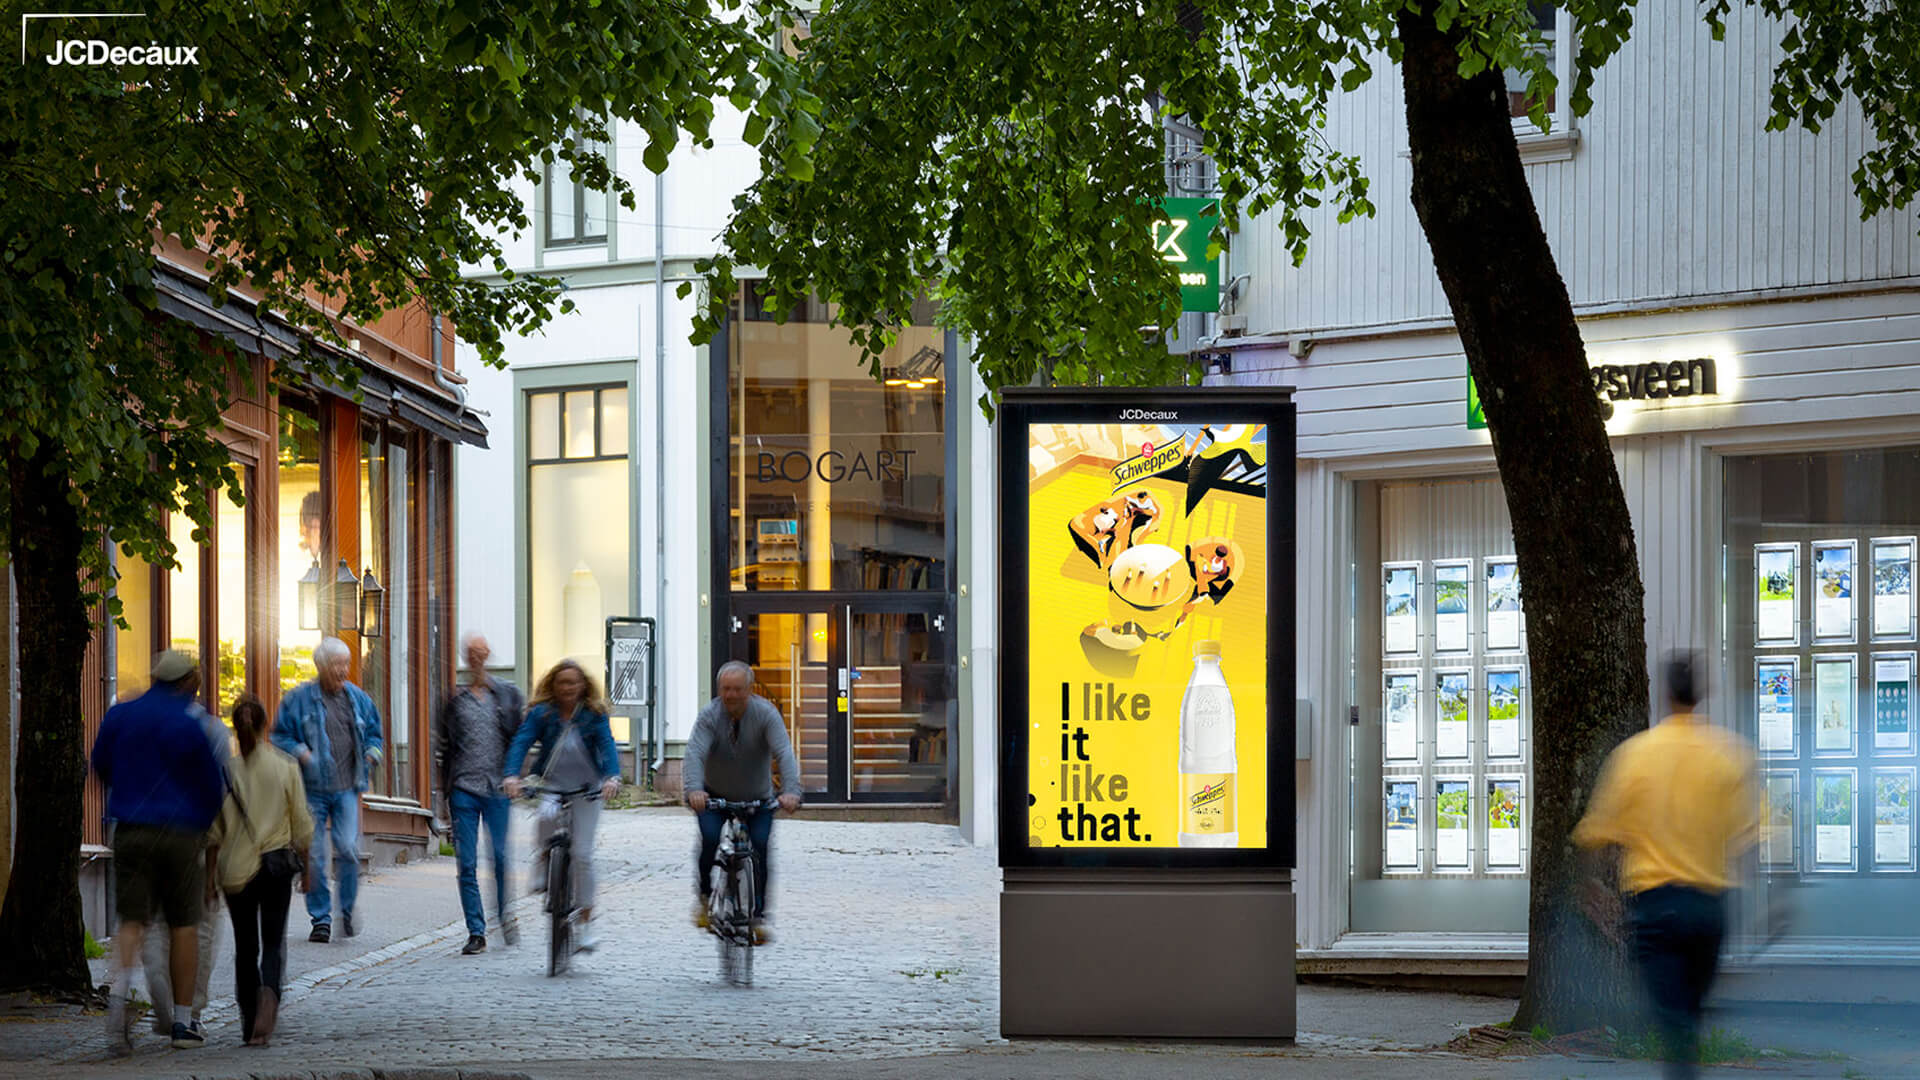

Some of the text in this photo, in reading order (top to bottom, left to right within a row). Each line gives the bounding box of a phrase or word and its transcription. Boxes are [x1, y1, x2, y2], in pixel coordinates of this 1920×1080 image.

[1119, 409, 1179, 420] JCDecaux
[757, 450, 917, 483] BOGART
[1113, 443, 1182, 485] Schweppes
[1062, 682, 1070, 721] I
[1083, 682, 1151, 721] like
[1061, 723, 1090, 761] it
[1060, 764, 1129, 802] like
[1057, 803, 1152, 842] that.
